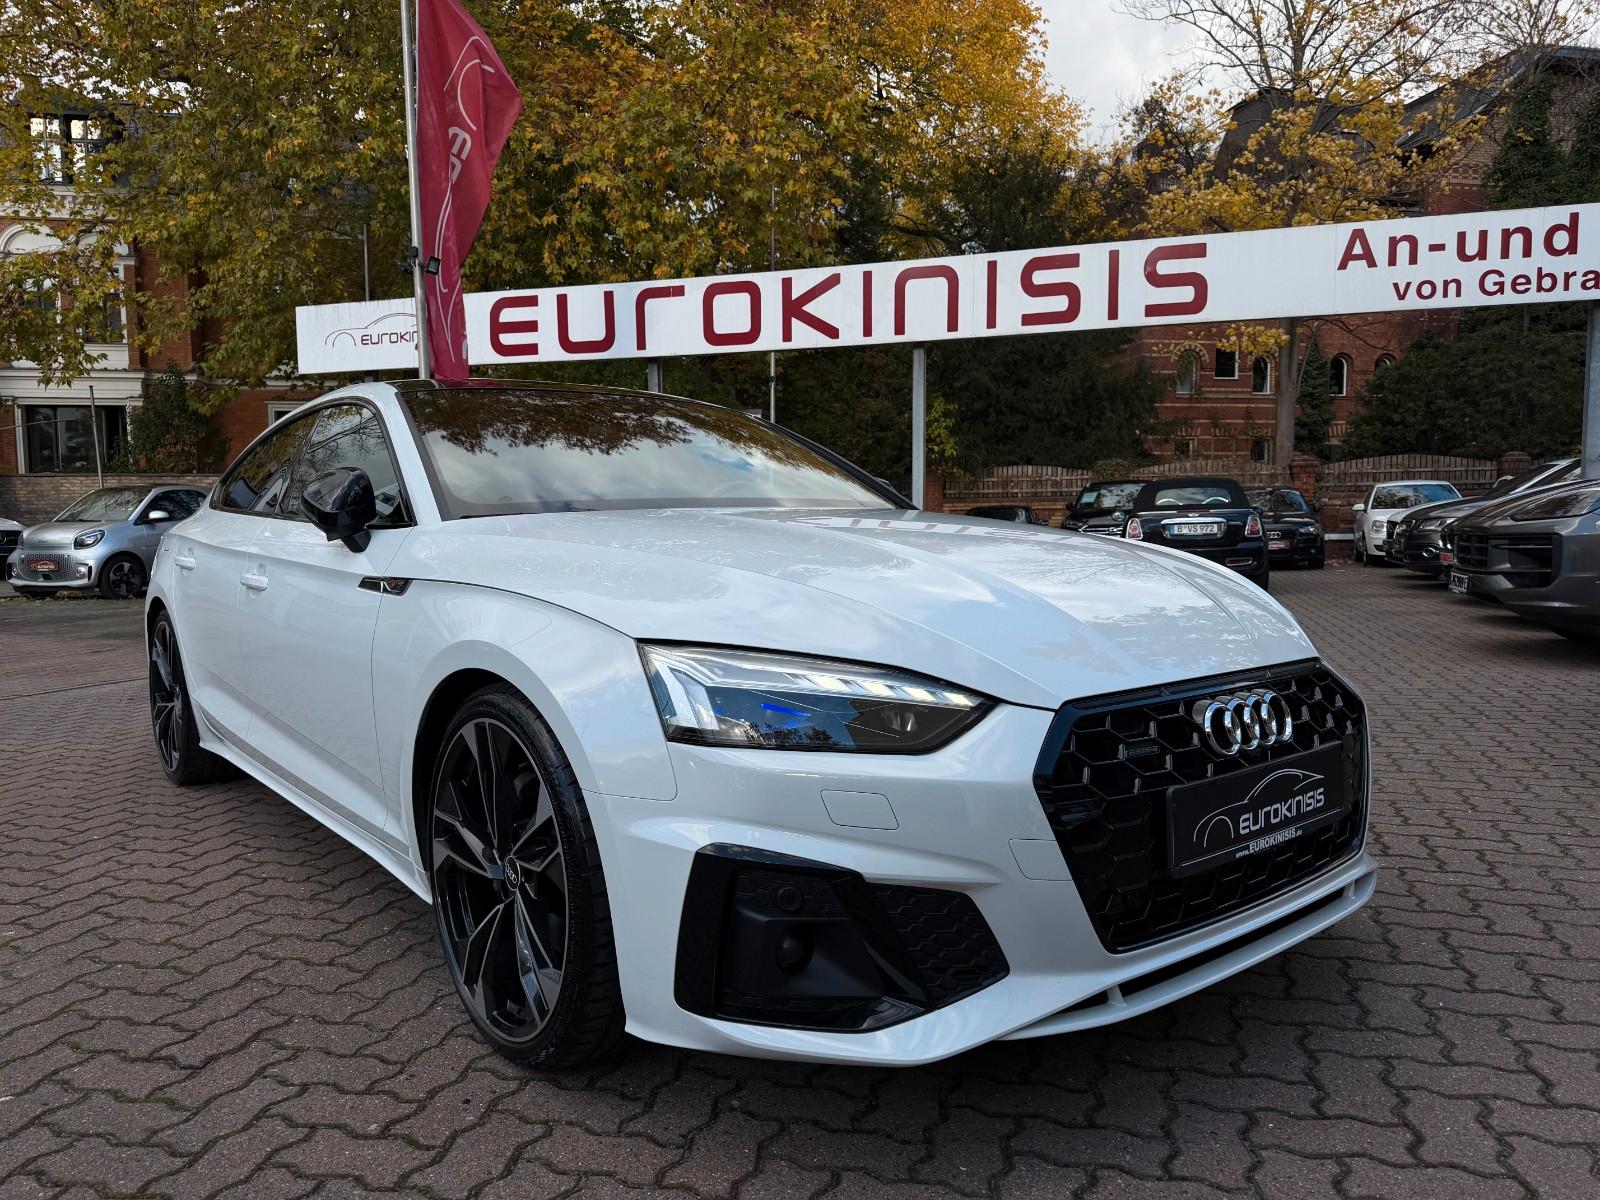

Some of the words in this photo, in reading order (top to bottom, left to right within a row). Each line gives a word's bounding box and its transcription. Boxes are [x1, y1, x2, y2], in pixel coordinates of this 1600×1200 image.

[1337, 212, 1579, 270] An-und
[490, 243, 1209, 357] EUROKINISIS
[1393, 278, 1462, 301] von
[1478, 267, 1600, 297] Gebra
[361, 331, 418, 345] EUROKIN
[1240, 787, 1325, 834] EUROKINISIS
